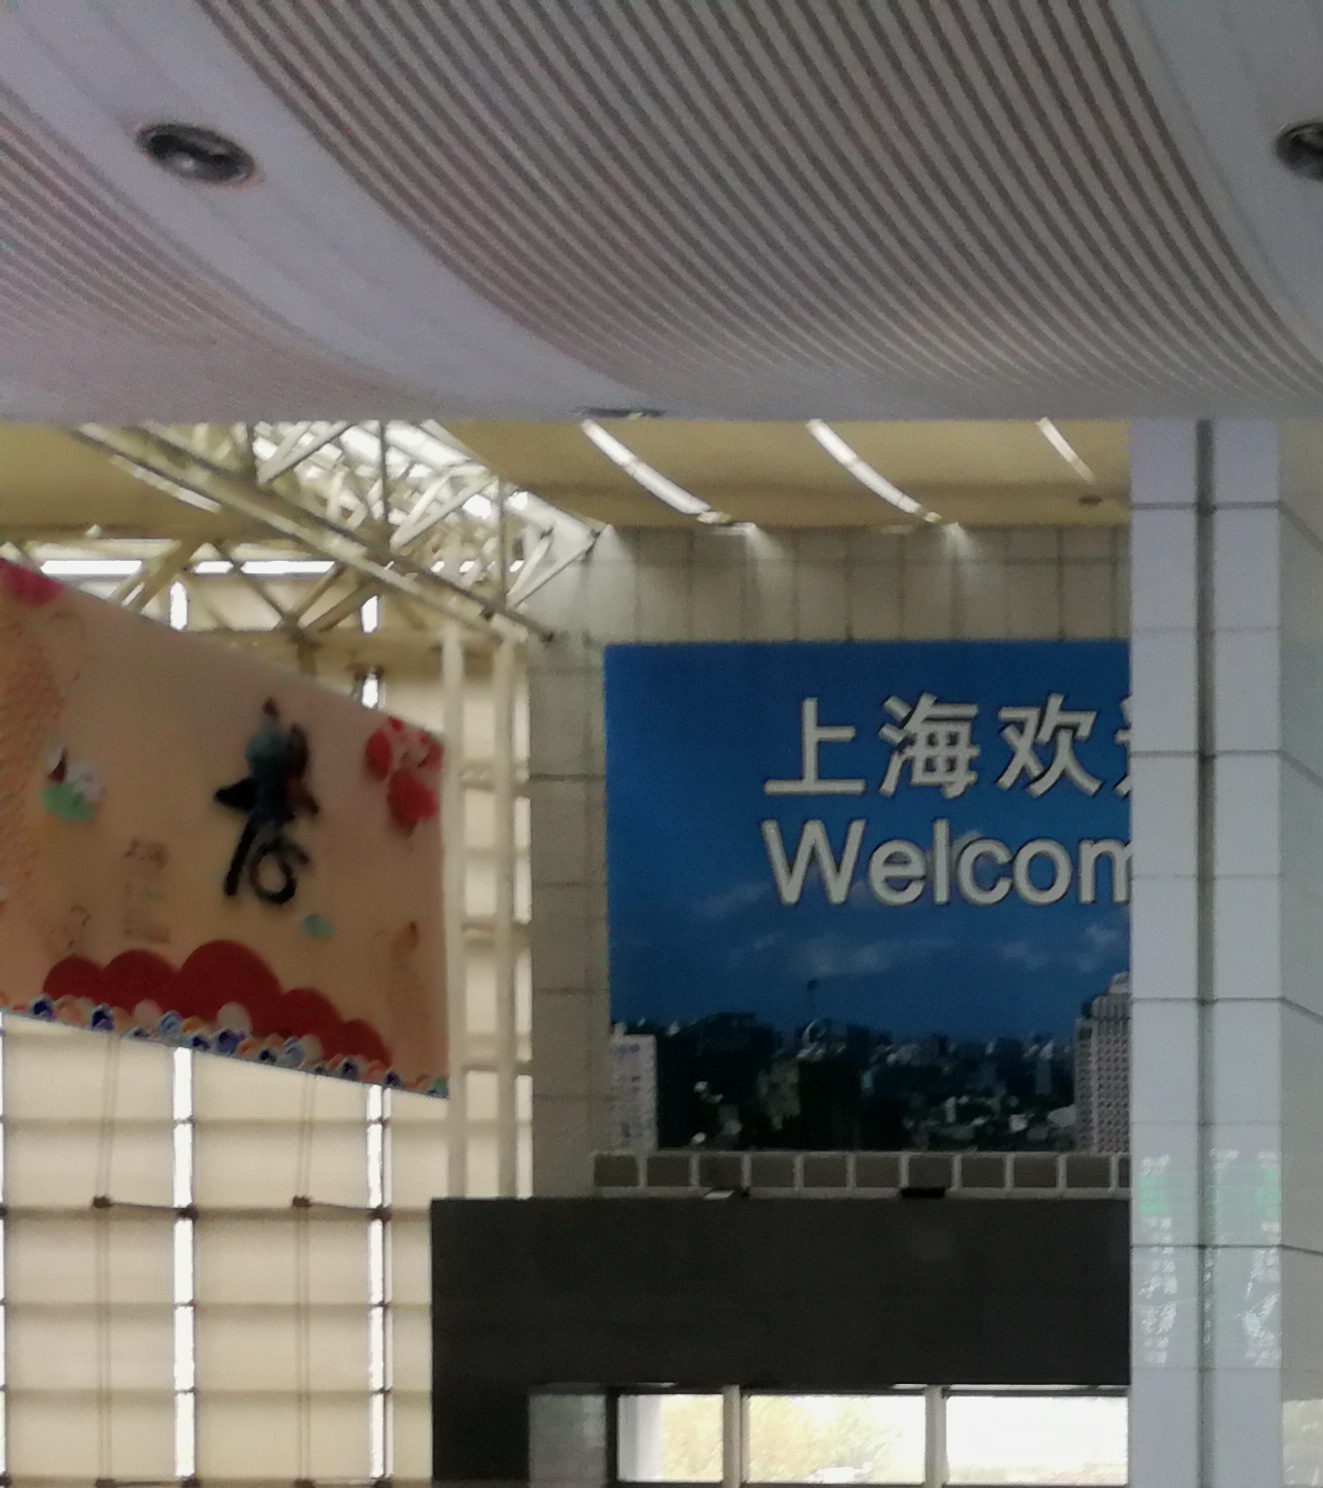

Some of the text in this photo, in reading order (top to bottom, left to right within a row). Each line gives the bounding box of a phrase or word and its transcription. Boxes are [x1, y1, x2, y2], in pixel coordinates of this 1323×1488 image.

[763, 693, 1131, 799] 上海欢
[761, 818, 1131, 906] Welcom
